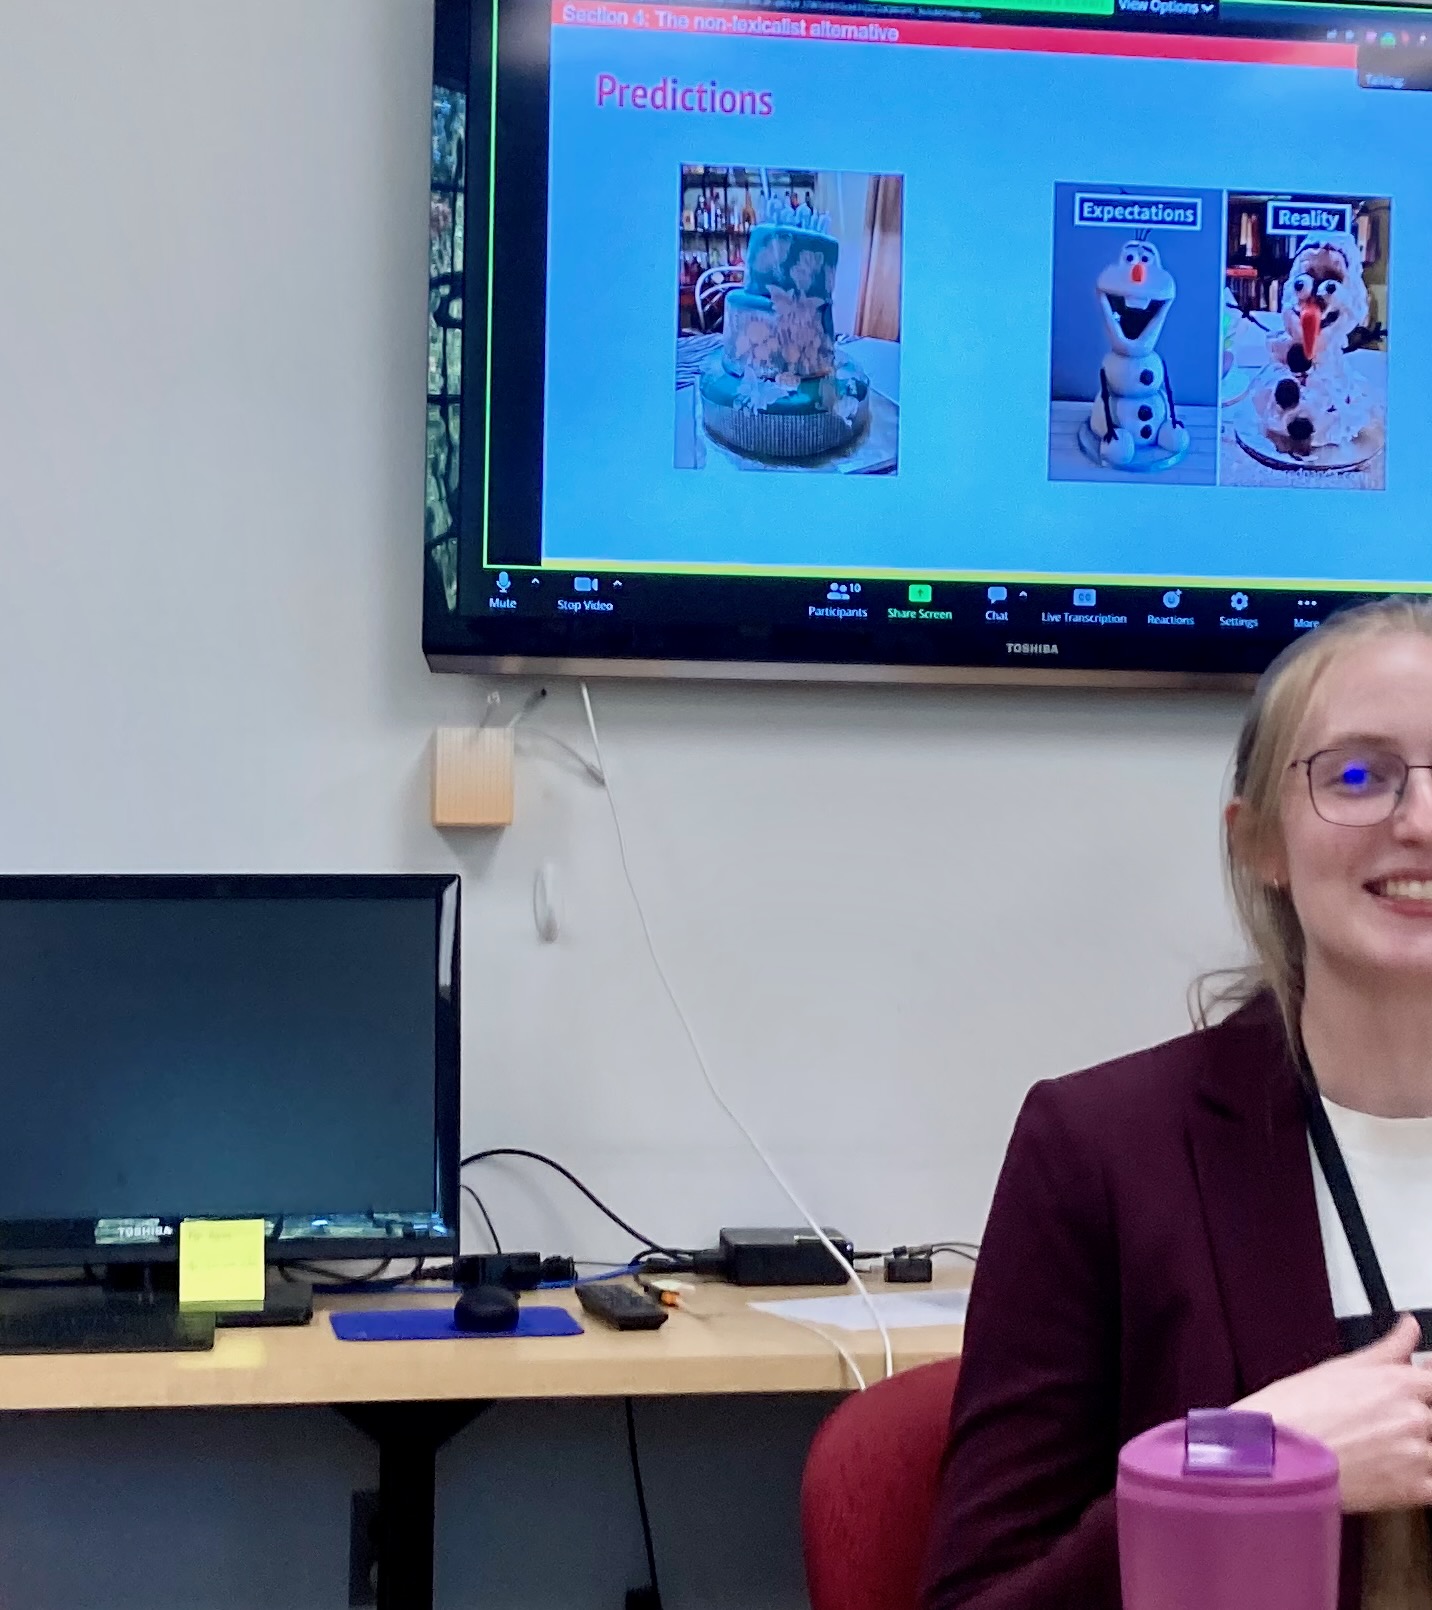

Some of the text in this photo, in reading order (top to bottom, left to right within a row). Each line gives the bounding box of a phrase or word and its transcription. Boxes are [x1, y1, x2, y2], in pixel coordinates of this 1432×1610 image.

[1150, 2, 1199, 15] Options
[562, 5, 628, 26] Section
[655, 10, 689, 29] The
[694, 15, 805, 37] non-lexicalist
[810, 20, 899, 43] alternative
[596, 73, 774, 117] Predictions
[1082, 201, 1195, 223] Expectations
[1278, 209, 1340, 230] Reality
[849, 583, 862, 593] 10
[489, 597, 517, 609] Mute
[557, 599, 614, 612] Stop Video
[808, 606, 868, 620] Participants
[888, 608, 953, 620] Share Screen
[985, 610, 1009, 621] Chat
[1041, 612, 1128, 626] Live Transcription
[1147, 614, 1195, 626] Reactions
[1219, 616, 1259, 629] Settings
[1293, 617, 1320, 629] More
[1006, 642, 1059, 655] TOSHIBA
[118, 1225, 174, 1238] TOSHIBA
